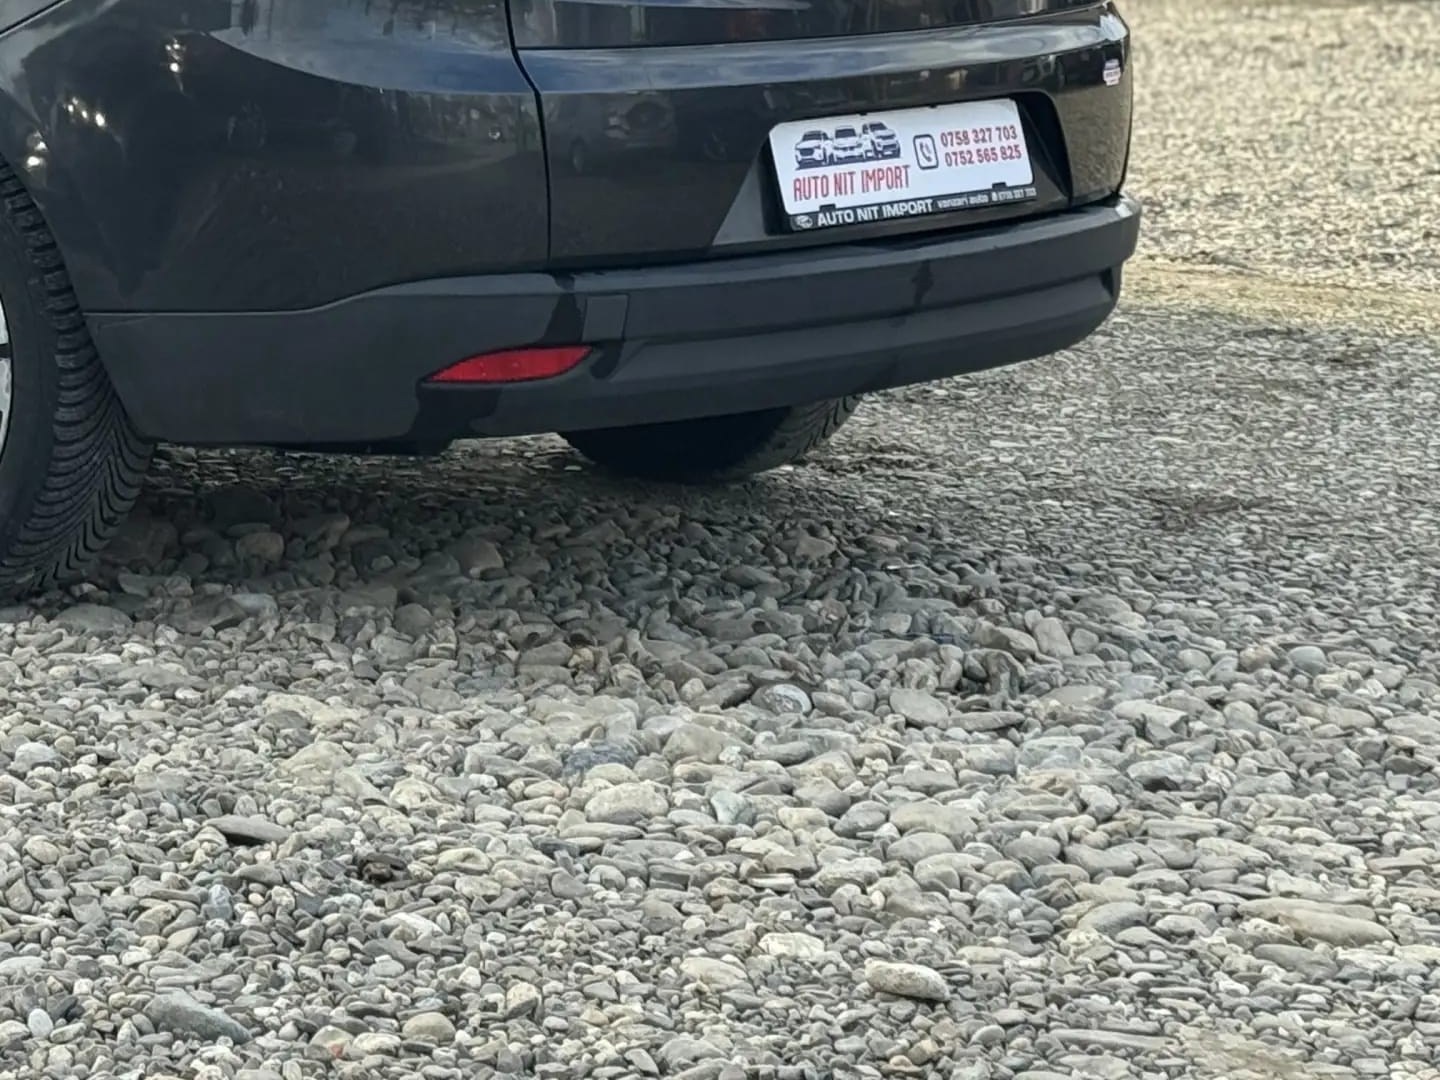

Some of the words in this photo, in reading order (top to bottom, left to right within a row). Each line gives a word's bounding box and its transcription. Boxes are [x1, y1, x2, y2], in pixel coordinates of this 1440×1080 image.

[940, 130, 971, 147] 0758
[972, 127, 993, 144] 327
[995, 125, 1018, 141] 703
[944, 149, 975, 167] 0752
[976, 146, 999, 163] 565
[1000, 143, 1023, 160] 825
[793, 175, 830, 202] AUTO
[833, 171, 857, 197] NIT
[861, 165, 910, 193] IMPORT
[817, 208, 854, 227] AUTO
[856, 205, 880, 222] NIT
[882, 198, 933, 218] IMPORT
